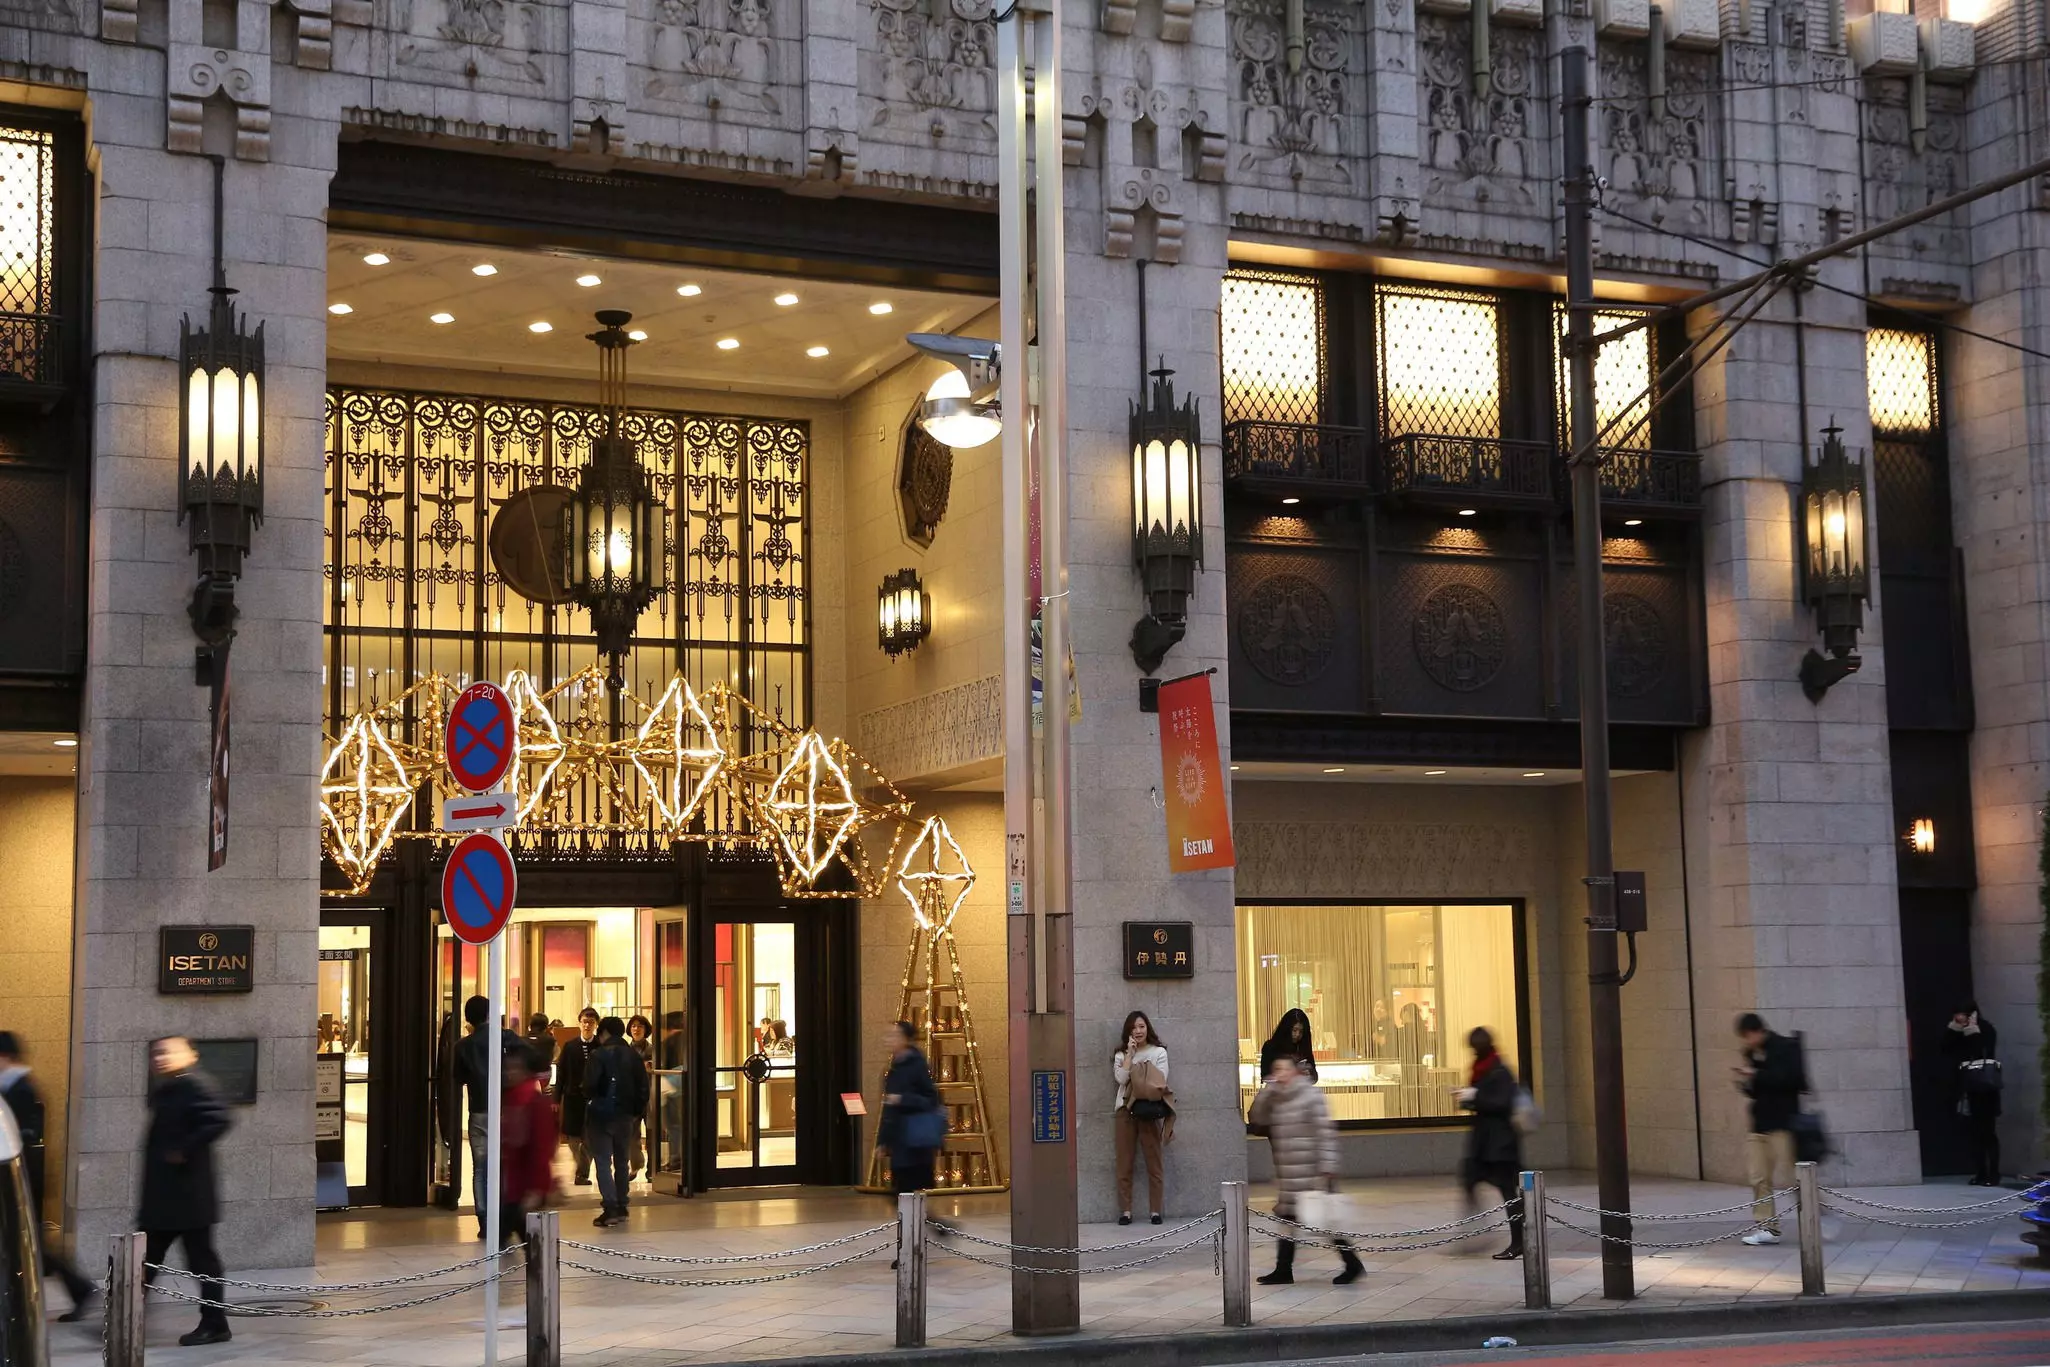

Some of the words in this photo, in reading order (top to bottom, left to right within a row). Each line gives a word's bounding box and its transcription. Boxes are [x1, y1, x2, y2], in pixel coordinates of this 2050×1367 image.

[467, 685, 495, 702] 7-20
[1183, 837, 1214, 857] ISETAN
[169, 955, 247, 971] ISETAN
[1136, 951, 1187, 966] 伊勢丹
[178, 977, 215, 986] DEPARTMENT
[217, 977, 236, 986] STORE
